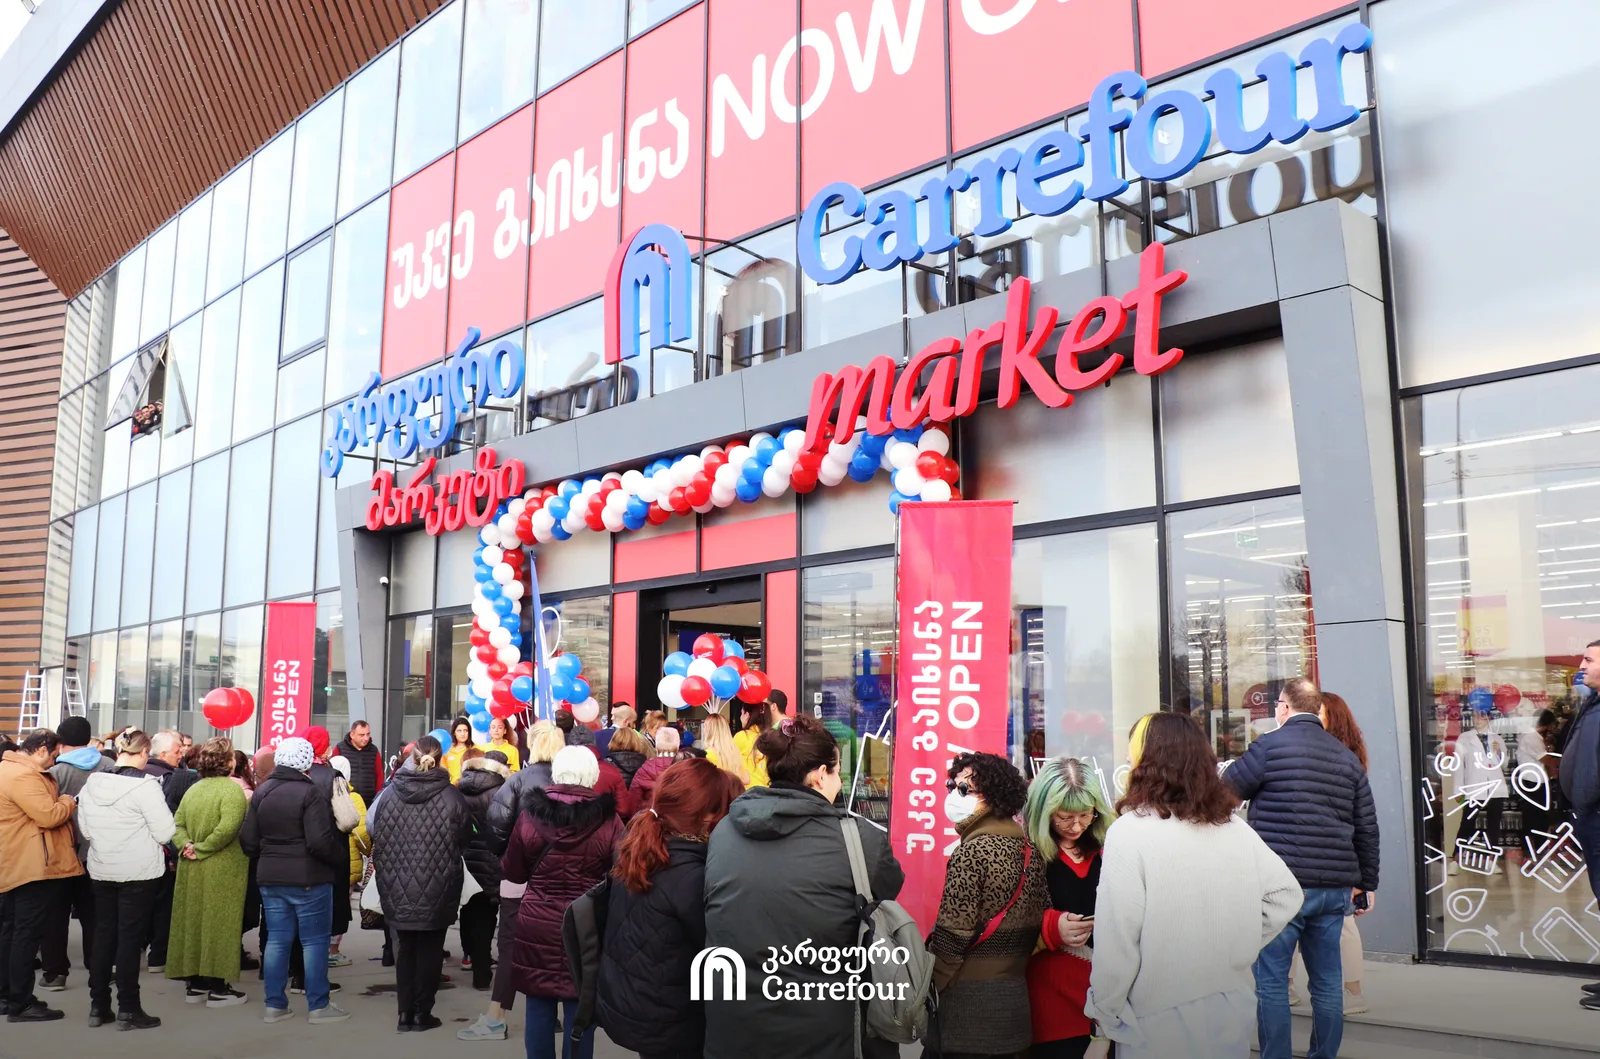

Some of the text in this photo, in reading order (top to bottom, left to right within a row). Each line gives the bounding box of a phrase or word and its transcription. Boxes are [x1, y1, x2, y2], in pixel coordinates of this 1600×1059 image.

[711, 0, 926, 158] NOW
[799, 22, 1373, 285] Carrefour
[392, 98, 690, 309] უკვე გაიხსნა
[321, 326, 525, 478] კარფური
[802, 241, 1188, 452] market
[365, 447, 526, 536] მარკეტი
[285, 660, 301, 735] OPEN
[906, 600, 944, 854] უკვე გაიხსნა
[947, 601, 984, 730] OPEN
